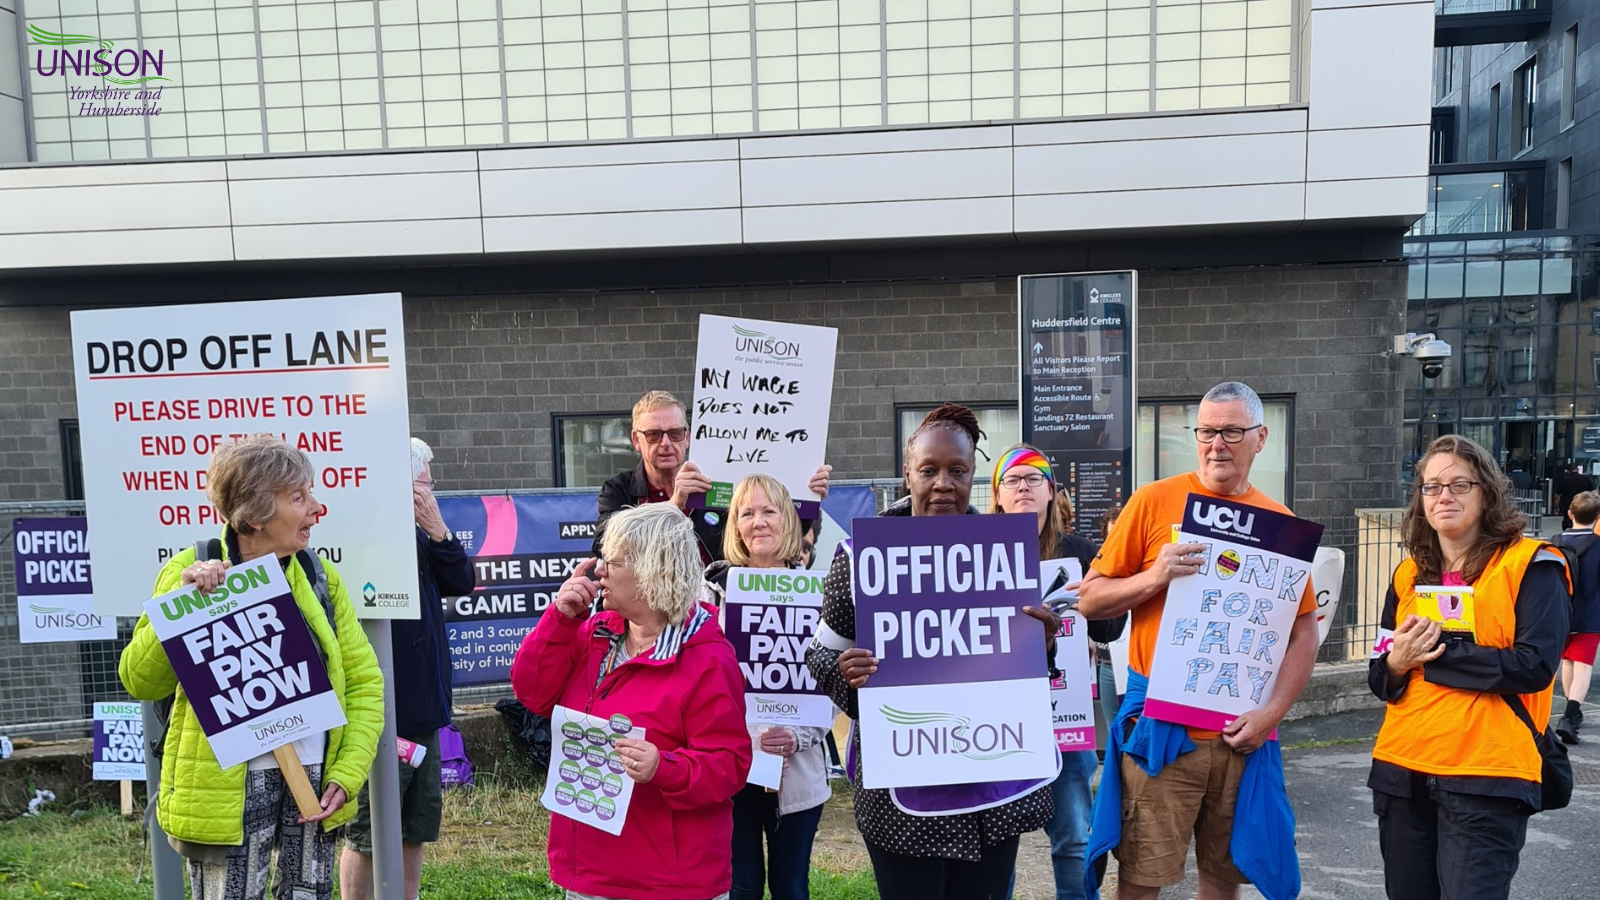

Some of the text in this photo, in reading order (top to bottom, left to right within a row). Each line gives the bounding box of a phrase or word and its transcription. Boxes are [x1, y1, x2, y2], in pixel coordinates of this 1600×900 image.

[1032, 316, 1121, 328] Huddersfield Centre
[86, 328, 389, 374] DROP OFF LANE
[735, 337, 800, 357] UNISON
[745, 356, 763, 364] public
[1044, 356, 1071, 364] Visitors
[1072, 355, 1095, 363] Please
[1096, 355, 1121, 364] Report
[701, 367, 800, 395] MY WAGE
[1043, 366, 1060, 374] Main
[1061, 366, 1096, 375] Reception
[114, 393, 367, 422] PLEASE DRIVE TO THE
[697, 397, 794, 419] DOES NOT
[1033, 393, 1092, 402] Accessible Route
[1034, 405, 1051, 413] Gym
[1034, 414, 1064, 422] Landings
[1075, 413, 1114, 421] Restaurant
[696, 424, 809, 443] ALLOW ME TO
[1034, 424, 1069, 433] Sanctuary
[141, 435, 186, 456] END
[193, 434, 222, 455] OF
[122, 470, 189, 491] WHEN
[322, 467, 367, 488] OFF
[159, 505, 192, 526] OR
[16, 530, 90, 554] OFFICI
[25, 560, 91, 584] PICKE
[476, 557, 587, 581] THE NEX
[858, 542, 1038, 597] OFFICIAL
[738, 573, 825, 594] UNISON
[208, 600, 239, 617] says
[455, 594, 526, 615] GAME
[769, 594, 794, 603] says
[1200, 588, 1274, 626] FOR
[35, 614, 101, 628] UNISON
[741, 605, 820, 635] FAIR
[182, 603, 286, 665] FAIR
[449, 629, 457, 640] 2
[461, 628, 484, 640] and
[488, 626, 495, 638] 3
[874, 606, 1015, 660] PICKET
[1171, 618, 1280, 665] FAIR
[474, 642, 485, 653] in
[489, 641, 520, 656] conju
[750, 635, 808, 662] PAY
[208, 634, 284, 691] PAY
[479, 656, 492, 668] of
[739, 662, 817, 691] NOW
[1184, 657, 1272, 704] PAY
[209, 661, 311, 726] NOW
[101, 705, 142, 715] UNISO
[757, 704, 798, 714] UNISON
[1052, 713, 1086, 724] CATION
[255, 714, 304, 740] UNISON
[109, 734, 144, 748] PAY
[892, 721, 1024, 757] UNISON
[102, 747, 145, 762] NOW
